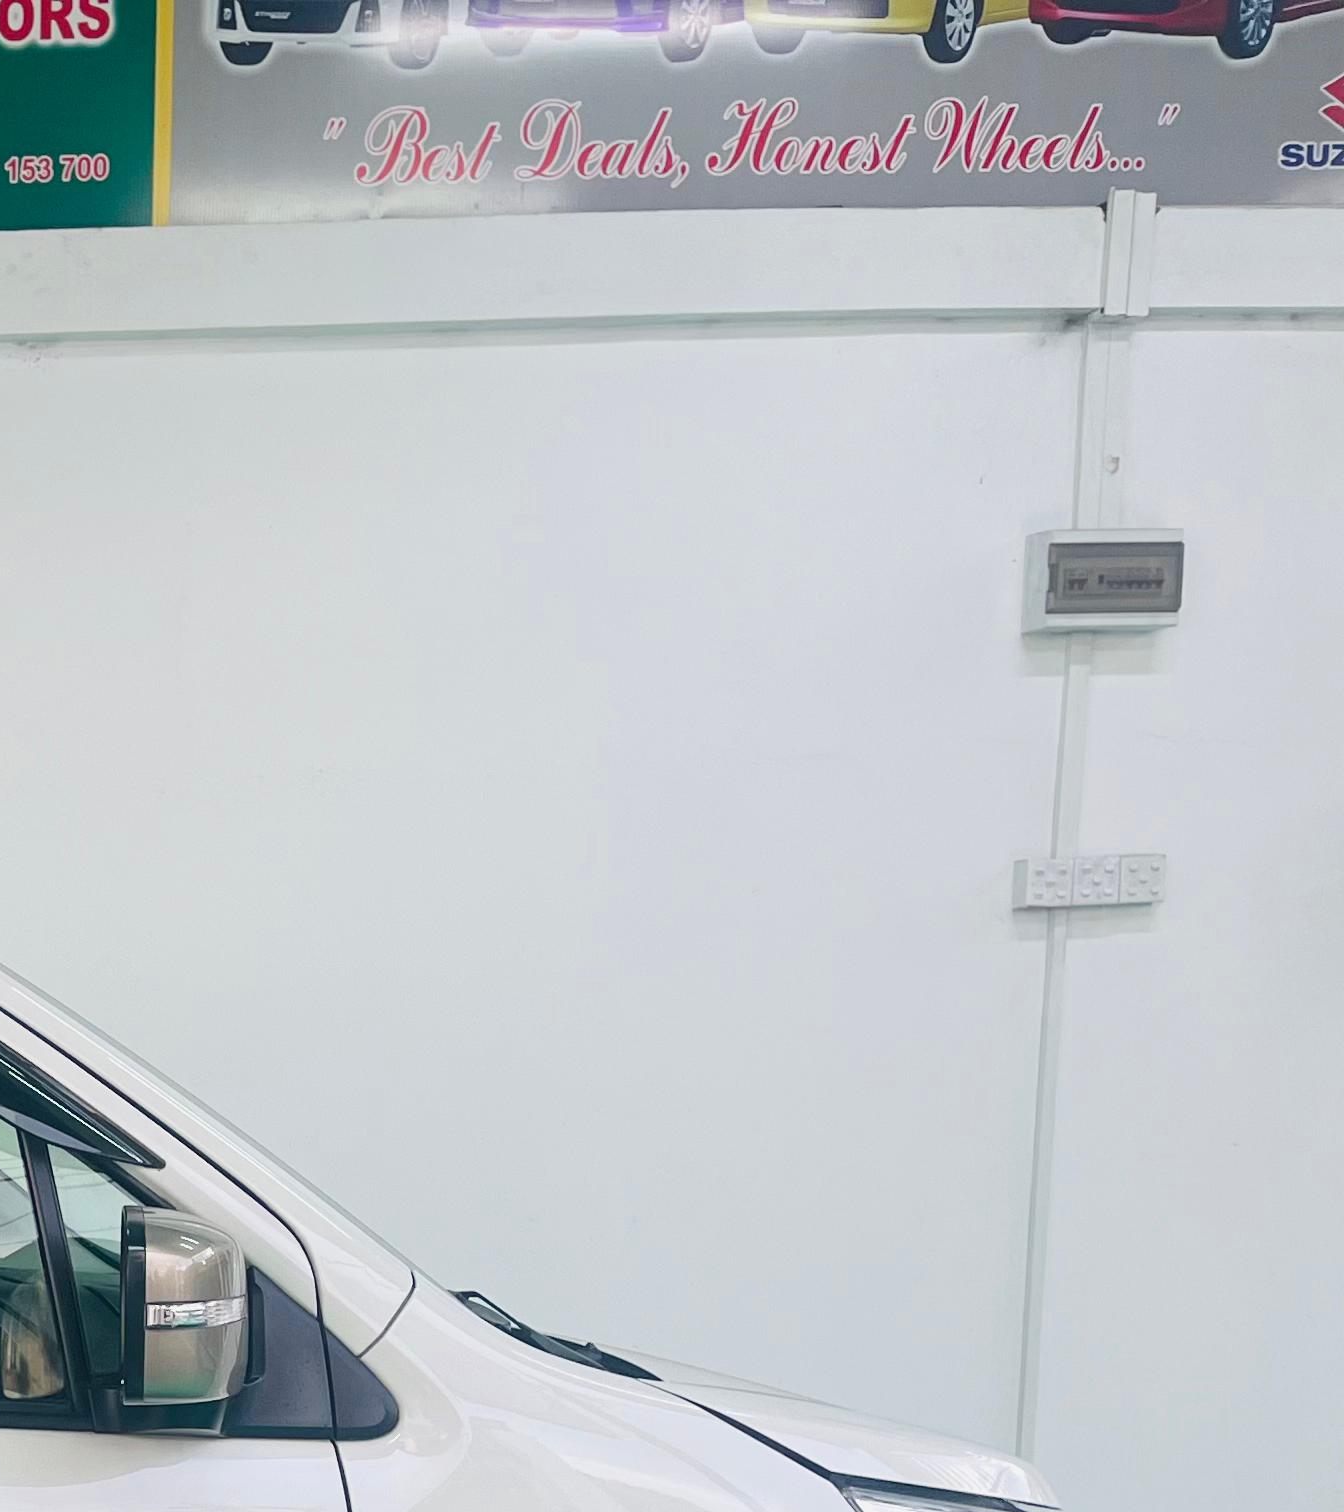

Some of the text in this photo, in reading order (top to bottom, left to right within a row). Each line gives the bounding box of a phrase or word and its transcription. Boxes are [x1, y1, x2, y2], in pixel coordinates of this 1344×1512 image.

[5, 155, 54, 183] 153
[60, 153, 110, 182] 700
[513, 98, 689, 188] Deals,
[705, 97, 916, 176] Honest
